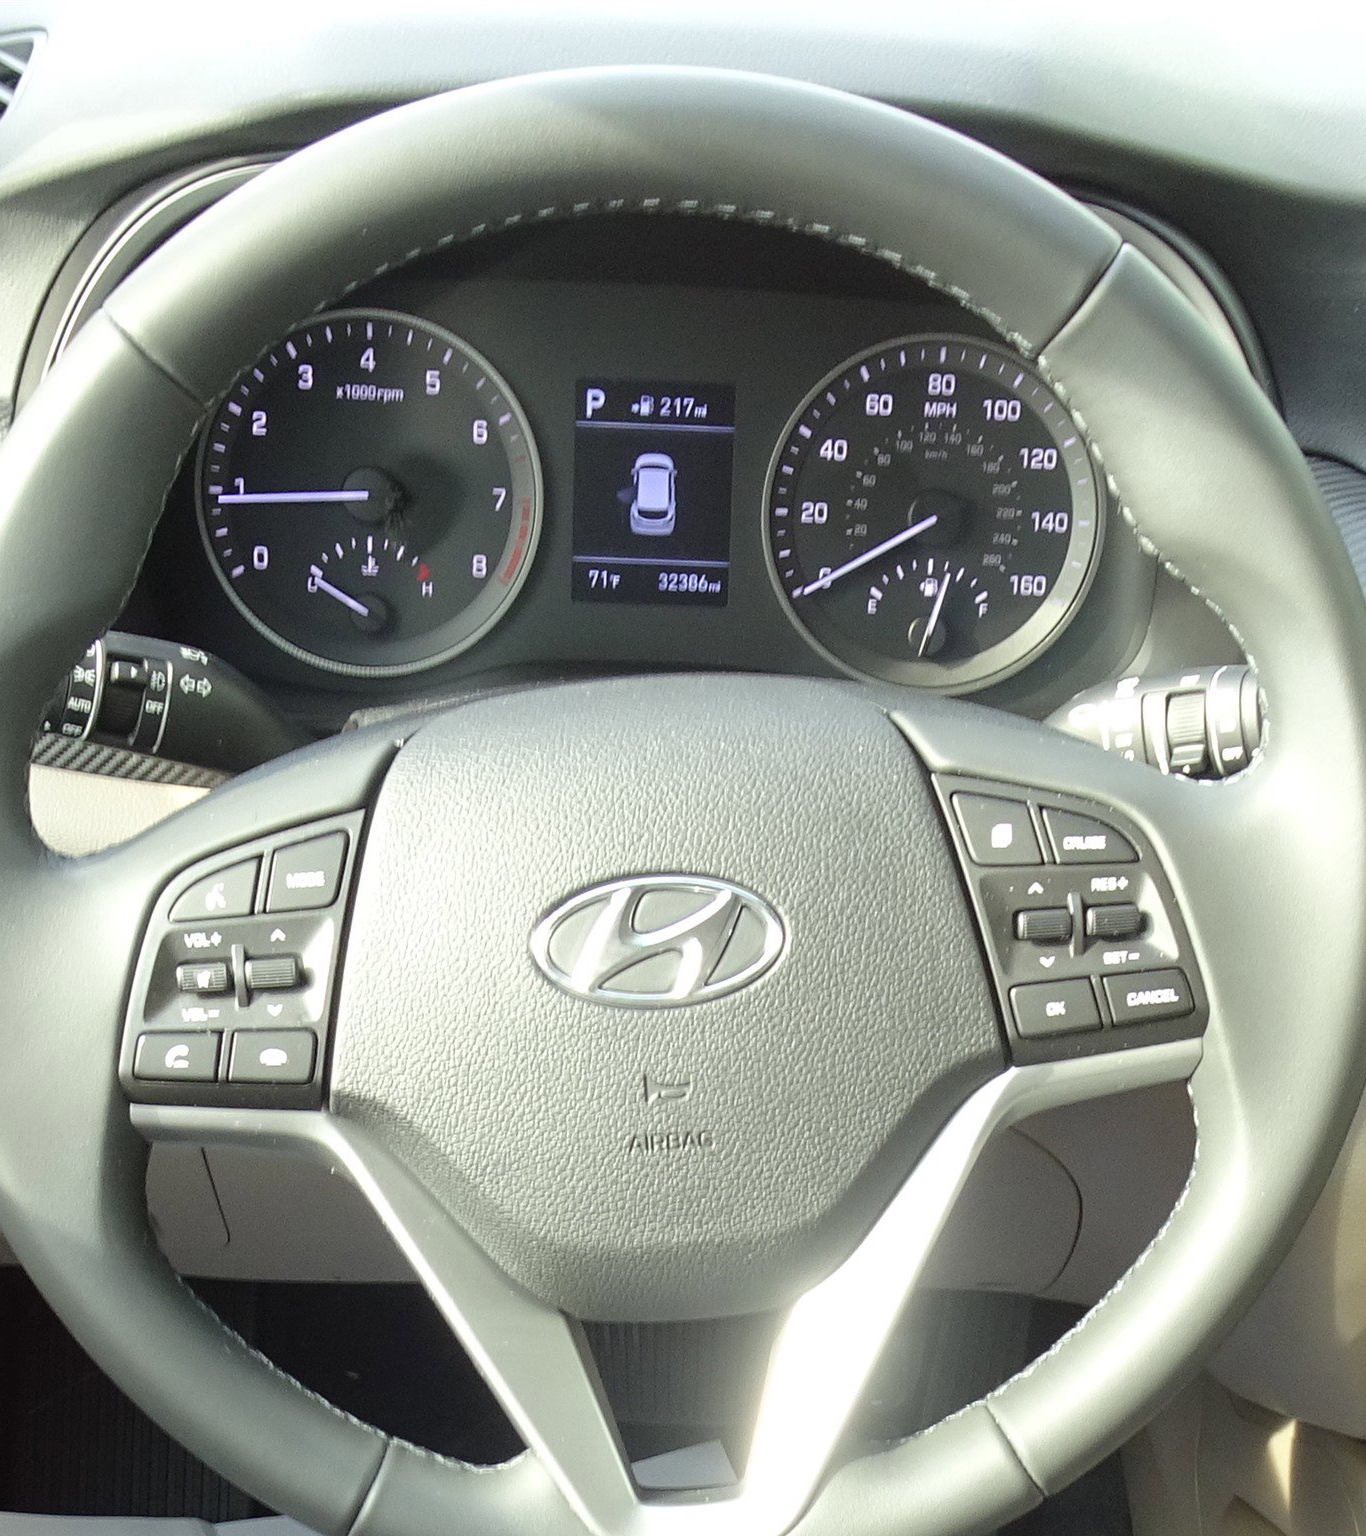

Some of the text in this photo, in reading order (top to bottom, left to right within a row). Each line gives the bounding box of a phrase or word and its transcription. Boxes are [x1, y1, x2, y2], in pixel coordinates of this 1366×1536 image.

[360, 347, 376, 373] 4
[298, 364, 313, 390] 3
[425, 369, 441, 396] 5
[927, 373, 956, 396] 80
[585, 388, 606, 419] P
[865, 393, 893, 416] 60
[924, 401, 957, 418] MPH
[983, 399, 1021, 421] 100
[251, 410, 267, 436] 2
[472, 419, 488, 445] 6
[819, 438, 848, 461] 40
[1019, 447, 1057, 470] 120
[492, 487, 506, 511] 7
[801, 501, 828, 524] 20
[1031, 511, 1068, 533] 140
[253, 545, 269, 570] 0
[472, 554, 487, 578] 8
[421, 581, 433, 598] H
[1010, 575, 1047, 596] 160
[867, 599, 877, 614] E
[979, 603, 988, 618] F
[67, 697, 92, 714] AUTO
[145, 700, 164, 715] OFF
[62, 722, 82, 738] OFF
[1126, 988, 1179, 1006] CANCEL
[1046, 1001, 1066, 1017] OK
[628, 1129, 716, 1154] AIRBAG
